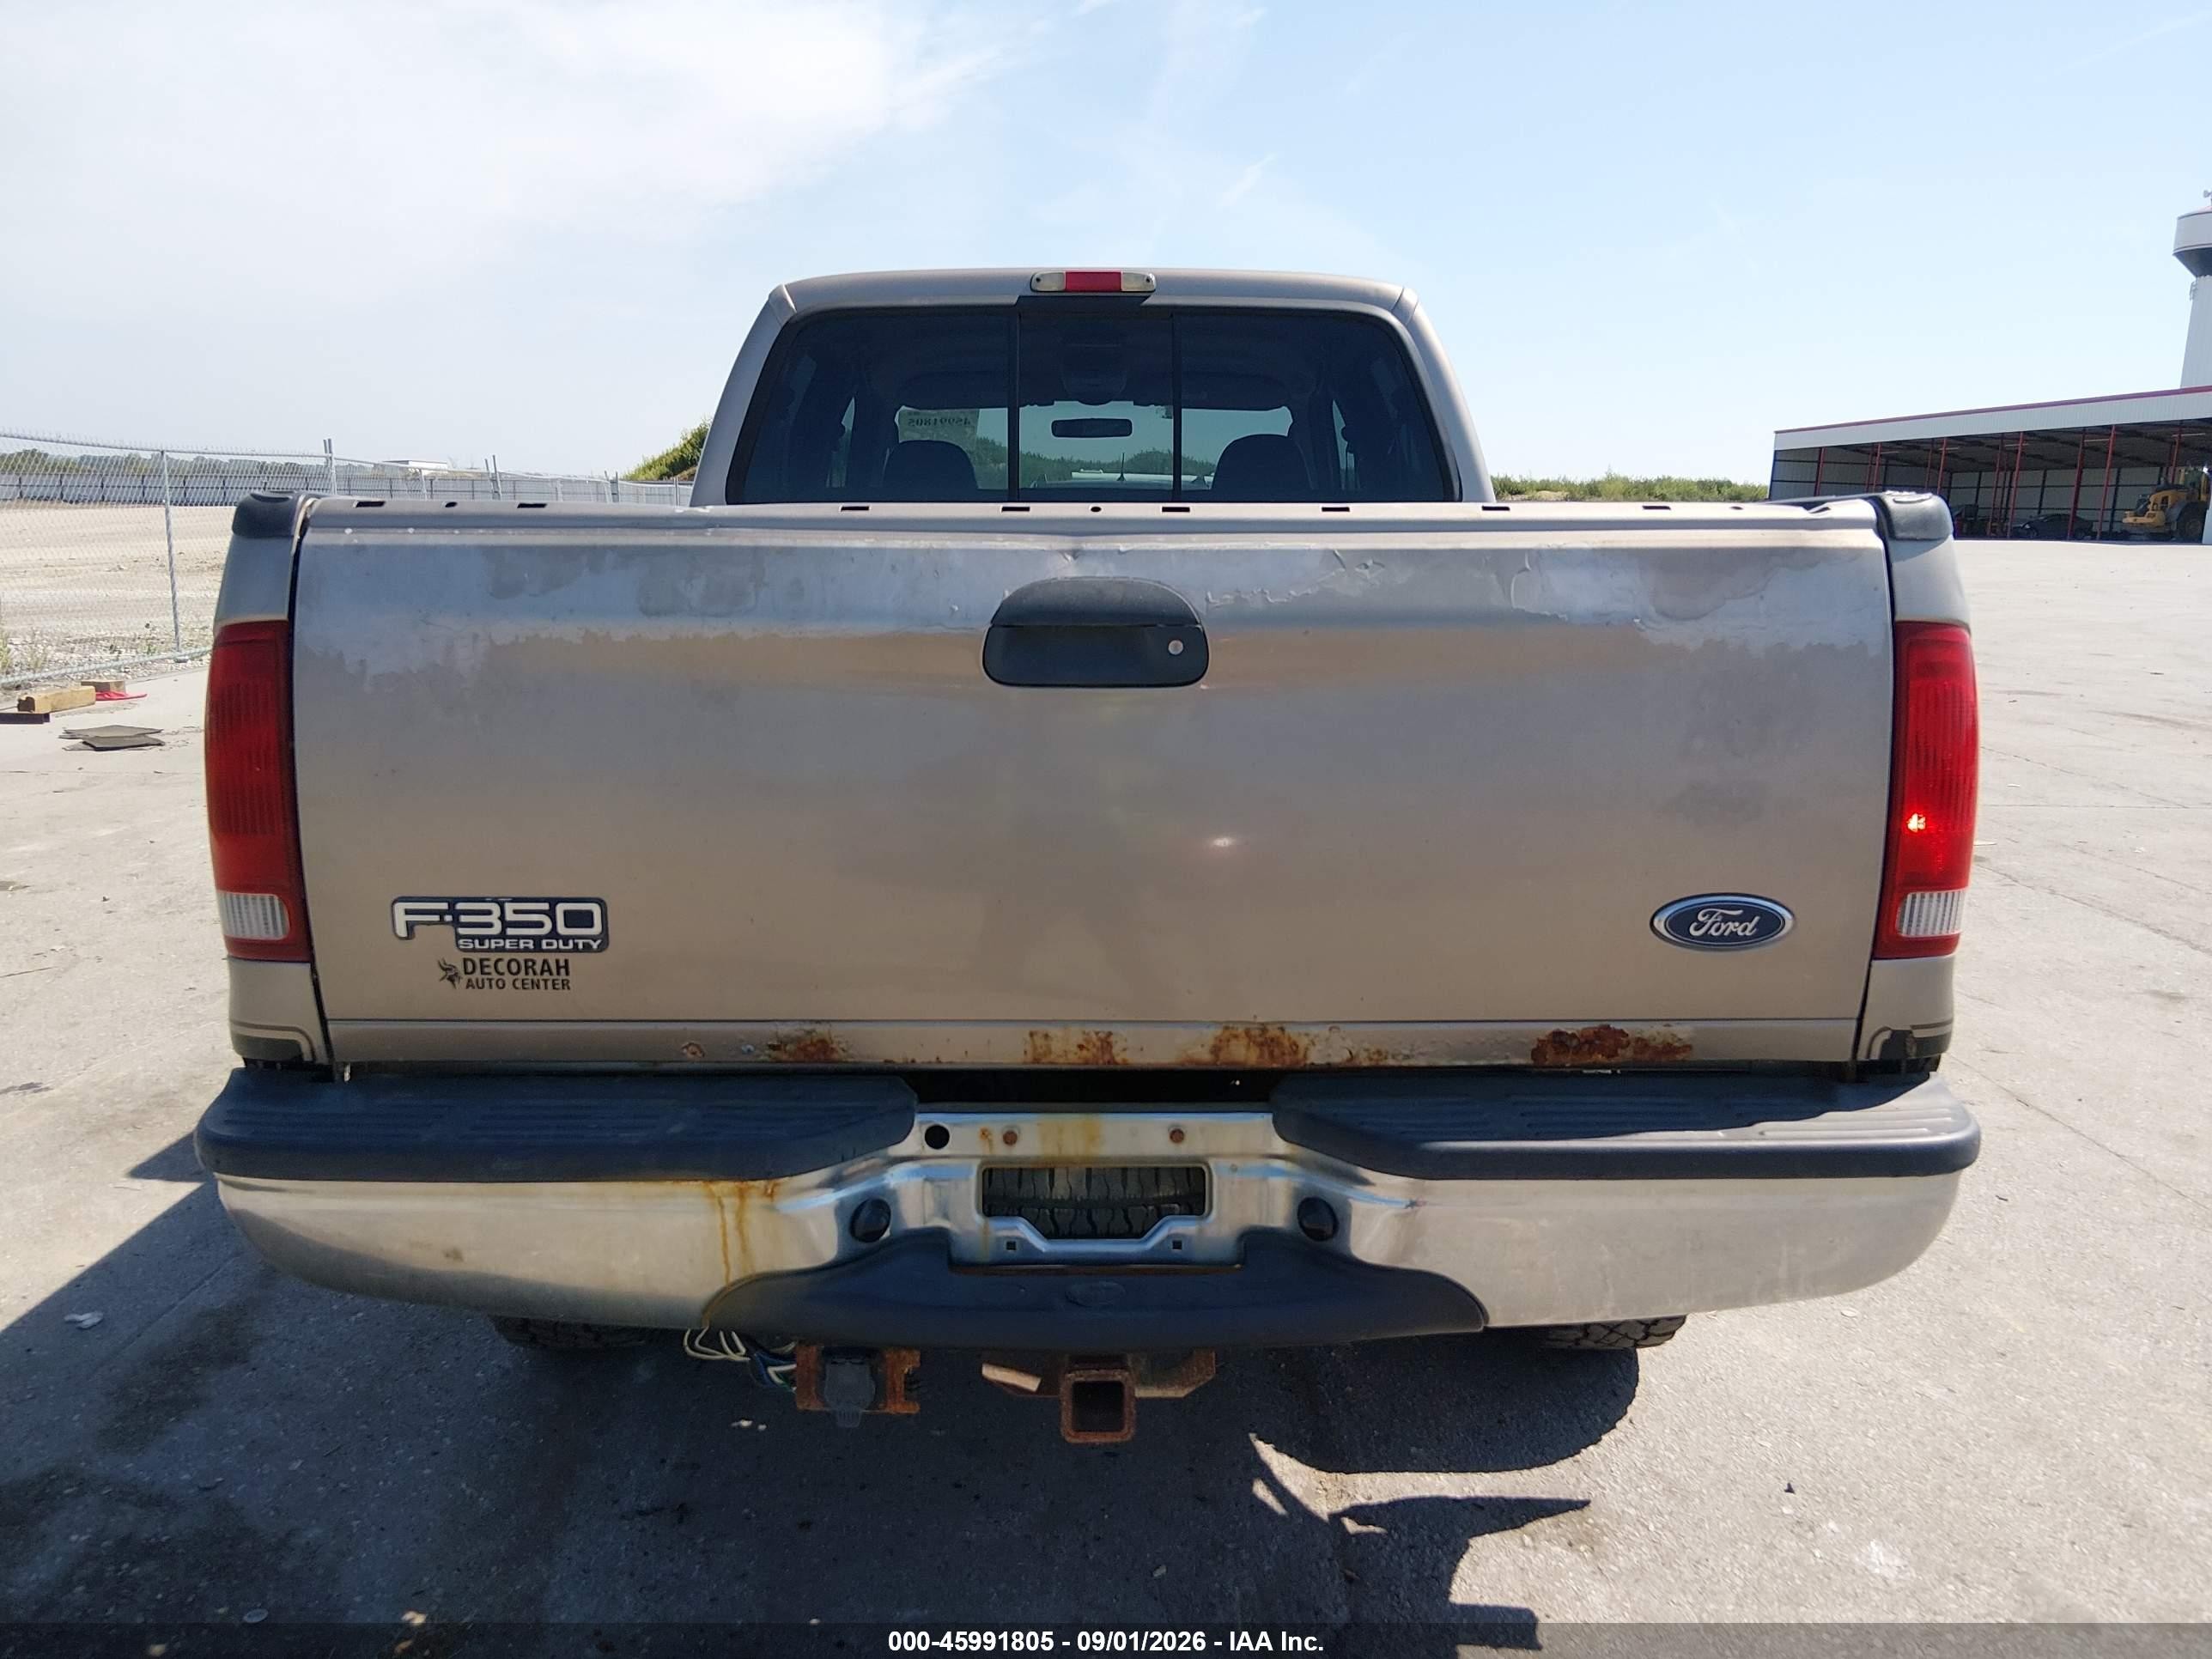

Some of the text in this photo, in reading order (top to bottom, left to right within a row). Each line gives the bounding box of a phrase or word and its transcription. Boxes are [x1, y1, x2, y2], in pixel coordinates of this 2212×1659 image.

[1689, 908, 1760, 937] Ford
[459, 939, 601, 950] SUPER DUTY
[464, 957, 570, 976] DECORAH
[465, 978, 570, 990] AUTO CENTER
